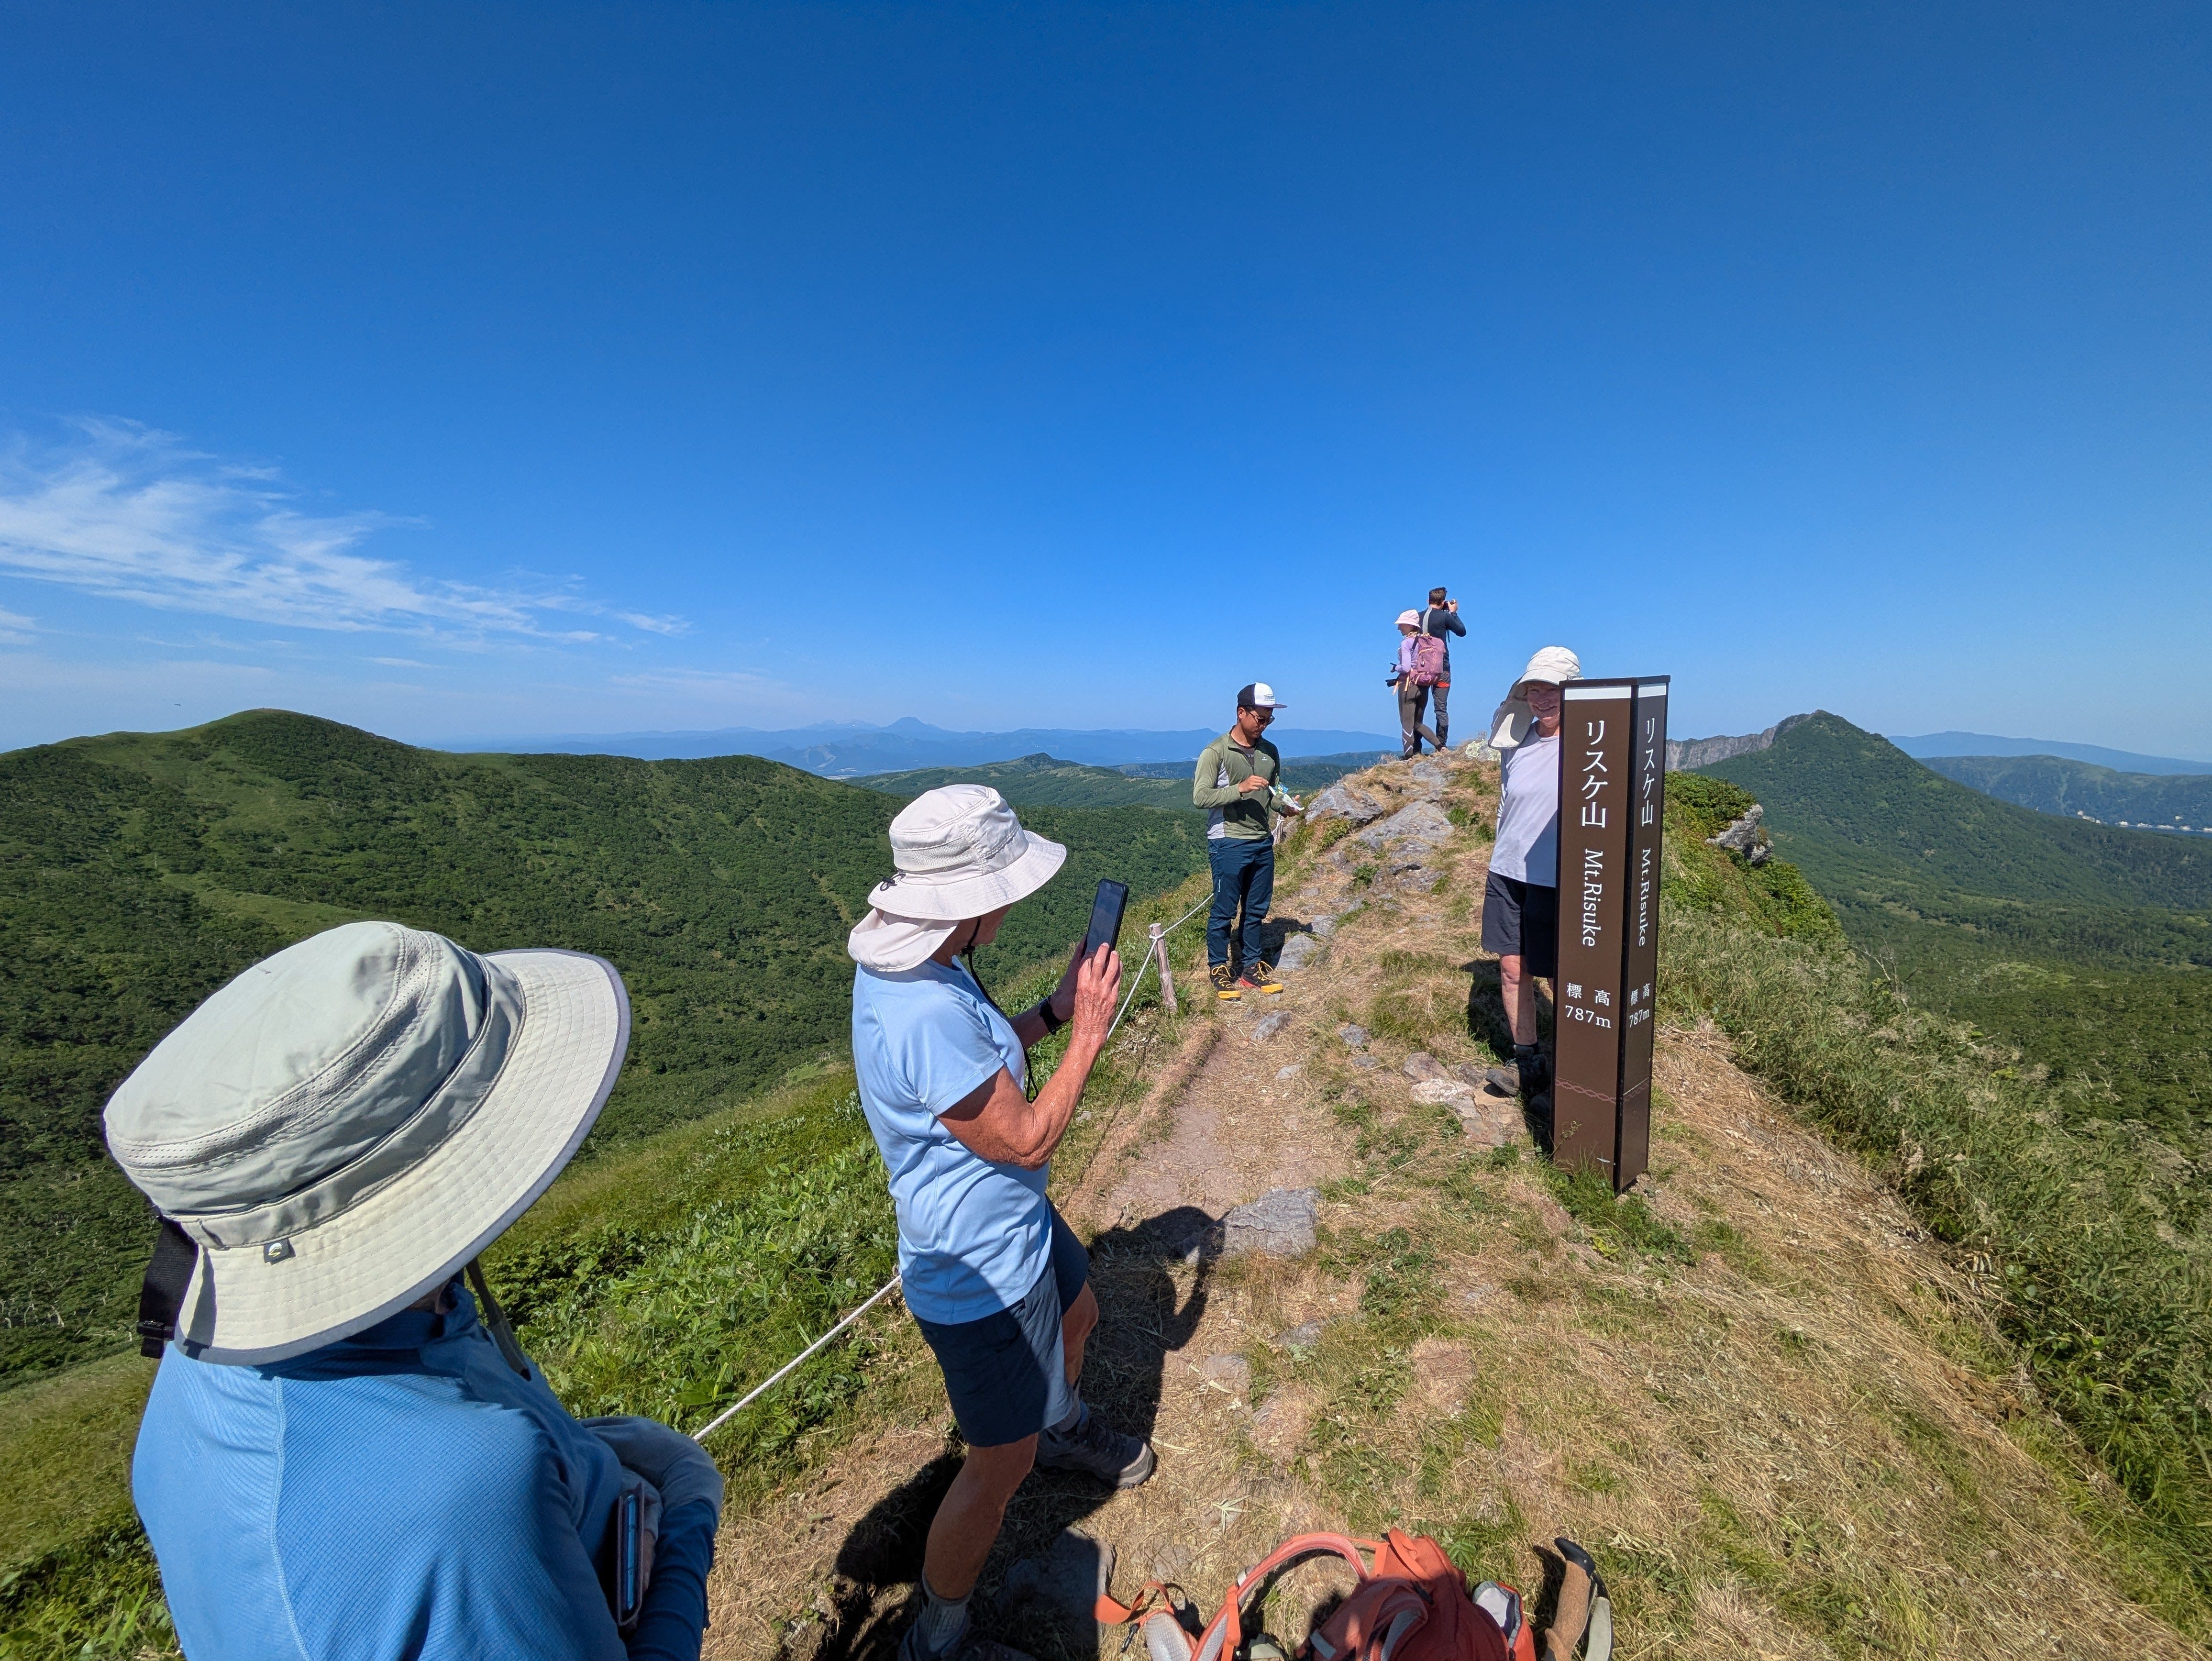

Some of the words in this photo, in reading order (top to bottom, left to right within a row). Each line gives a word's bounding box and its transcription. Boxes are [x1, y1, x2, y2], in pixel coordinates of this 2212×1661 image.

[1582, 720, 1608, 828] リスケ山
[1641, 718, 1655, 827] リスケ山
[1582, 848, 1604, 947] Mt.Risuke
[1639, 847, 1651, 947] Mt.Risuke
[1565, 1005, 1612, 1029] 787m
[1566, 982, 1611, 1006] 標高
[1629, 1008, 1649, 1028] 787m
